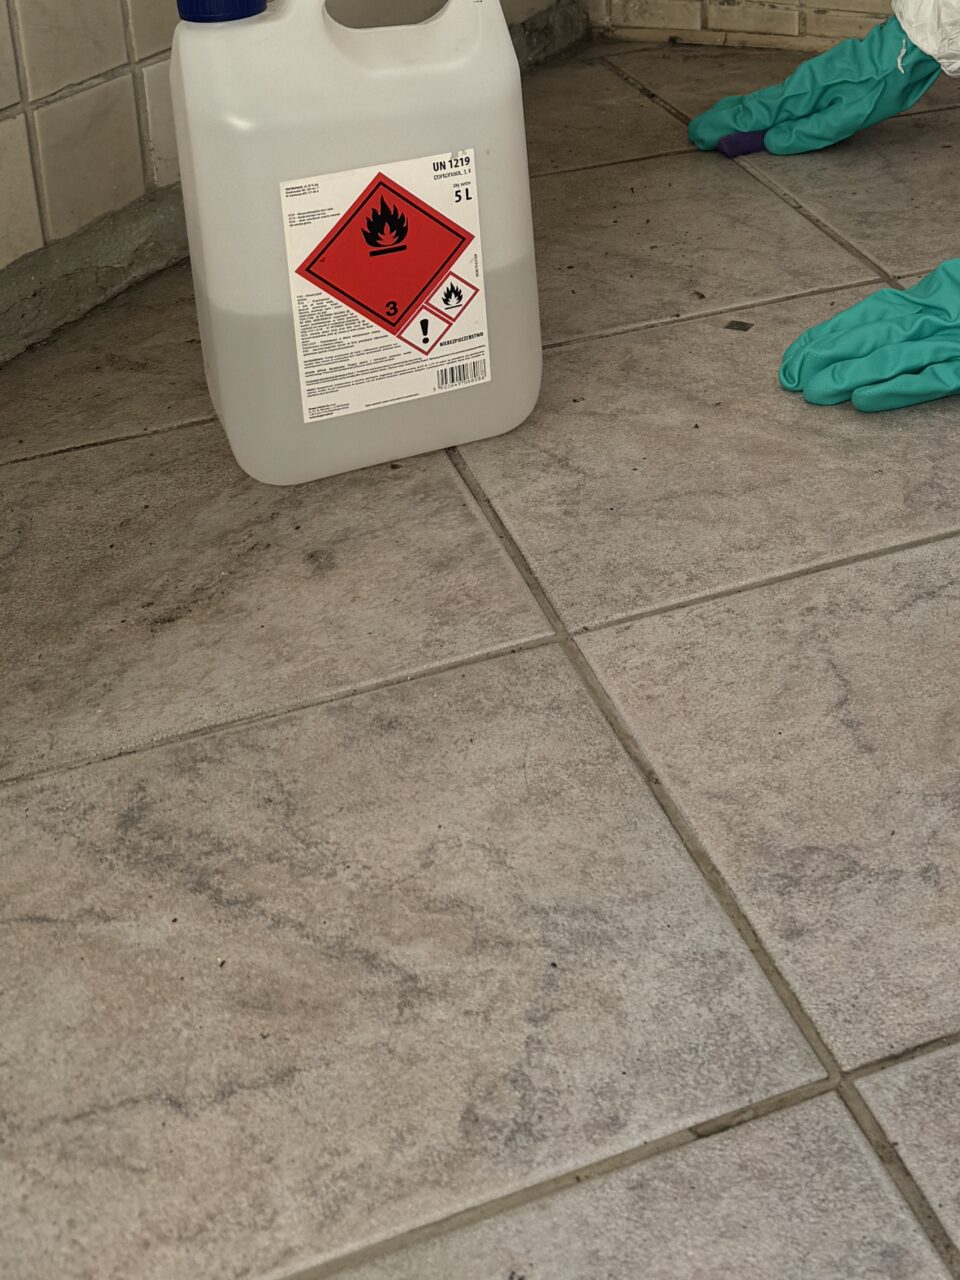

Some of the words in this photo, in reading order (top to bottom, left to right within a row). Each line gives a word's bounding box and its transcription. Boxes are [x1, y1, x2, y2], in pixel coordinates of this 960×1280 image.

[432, 161, 446, 171] UN
[448, 156, 470, 169] 1219
[455, 190, 462, 203] 5
[465, 187, 472, 200] L
[385, 301, 398, 316] 3
